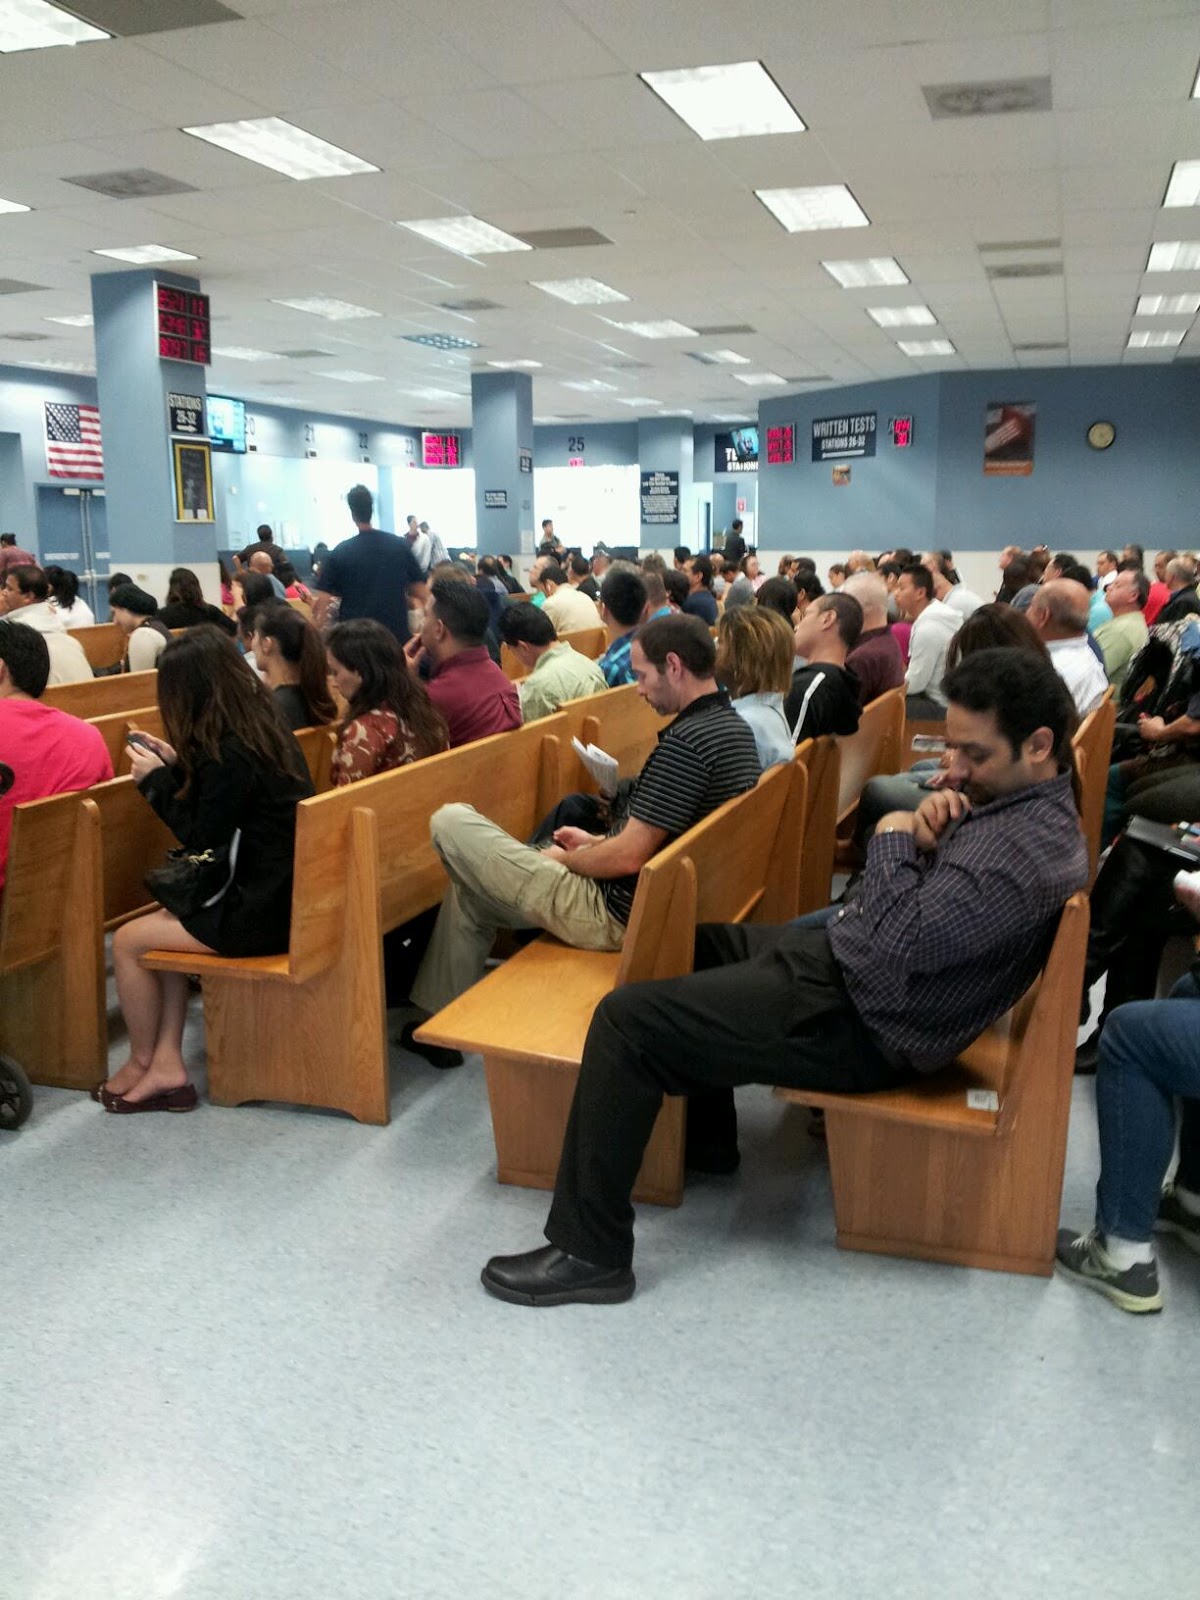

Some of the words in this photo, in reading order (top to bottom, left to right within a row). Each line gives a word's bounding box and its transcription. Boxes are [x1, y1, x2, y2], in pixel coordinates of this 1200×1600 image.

[169, 394, 202, 411] STATIONS
[813, 418, 849, 438] WRITTEN
[850, 415, 876, 434] TESTS
[359, 432, 368, 449] 22
[568, 437, 585, 452] 25
[821, 436, 848, 450] STATIONS
